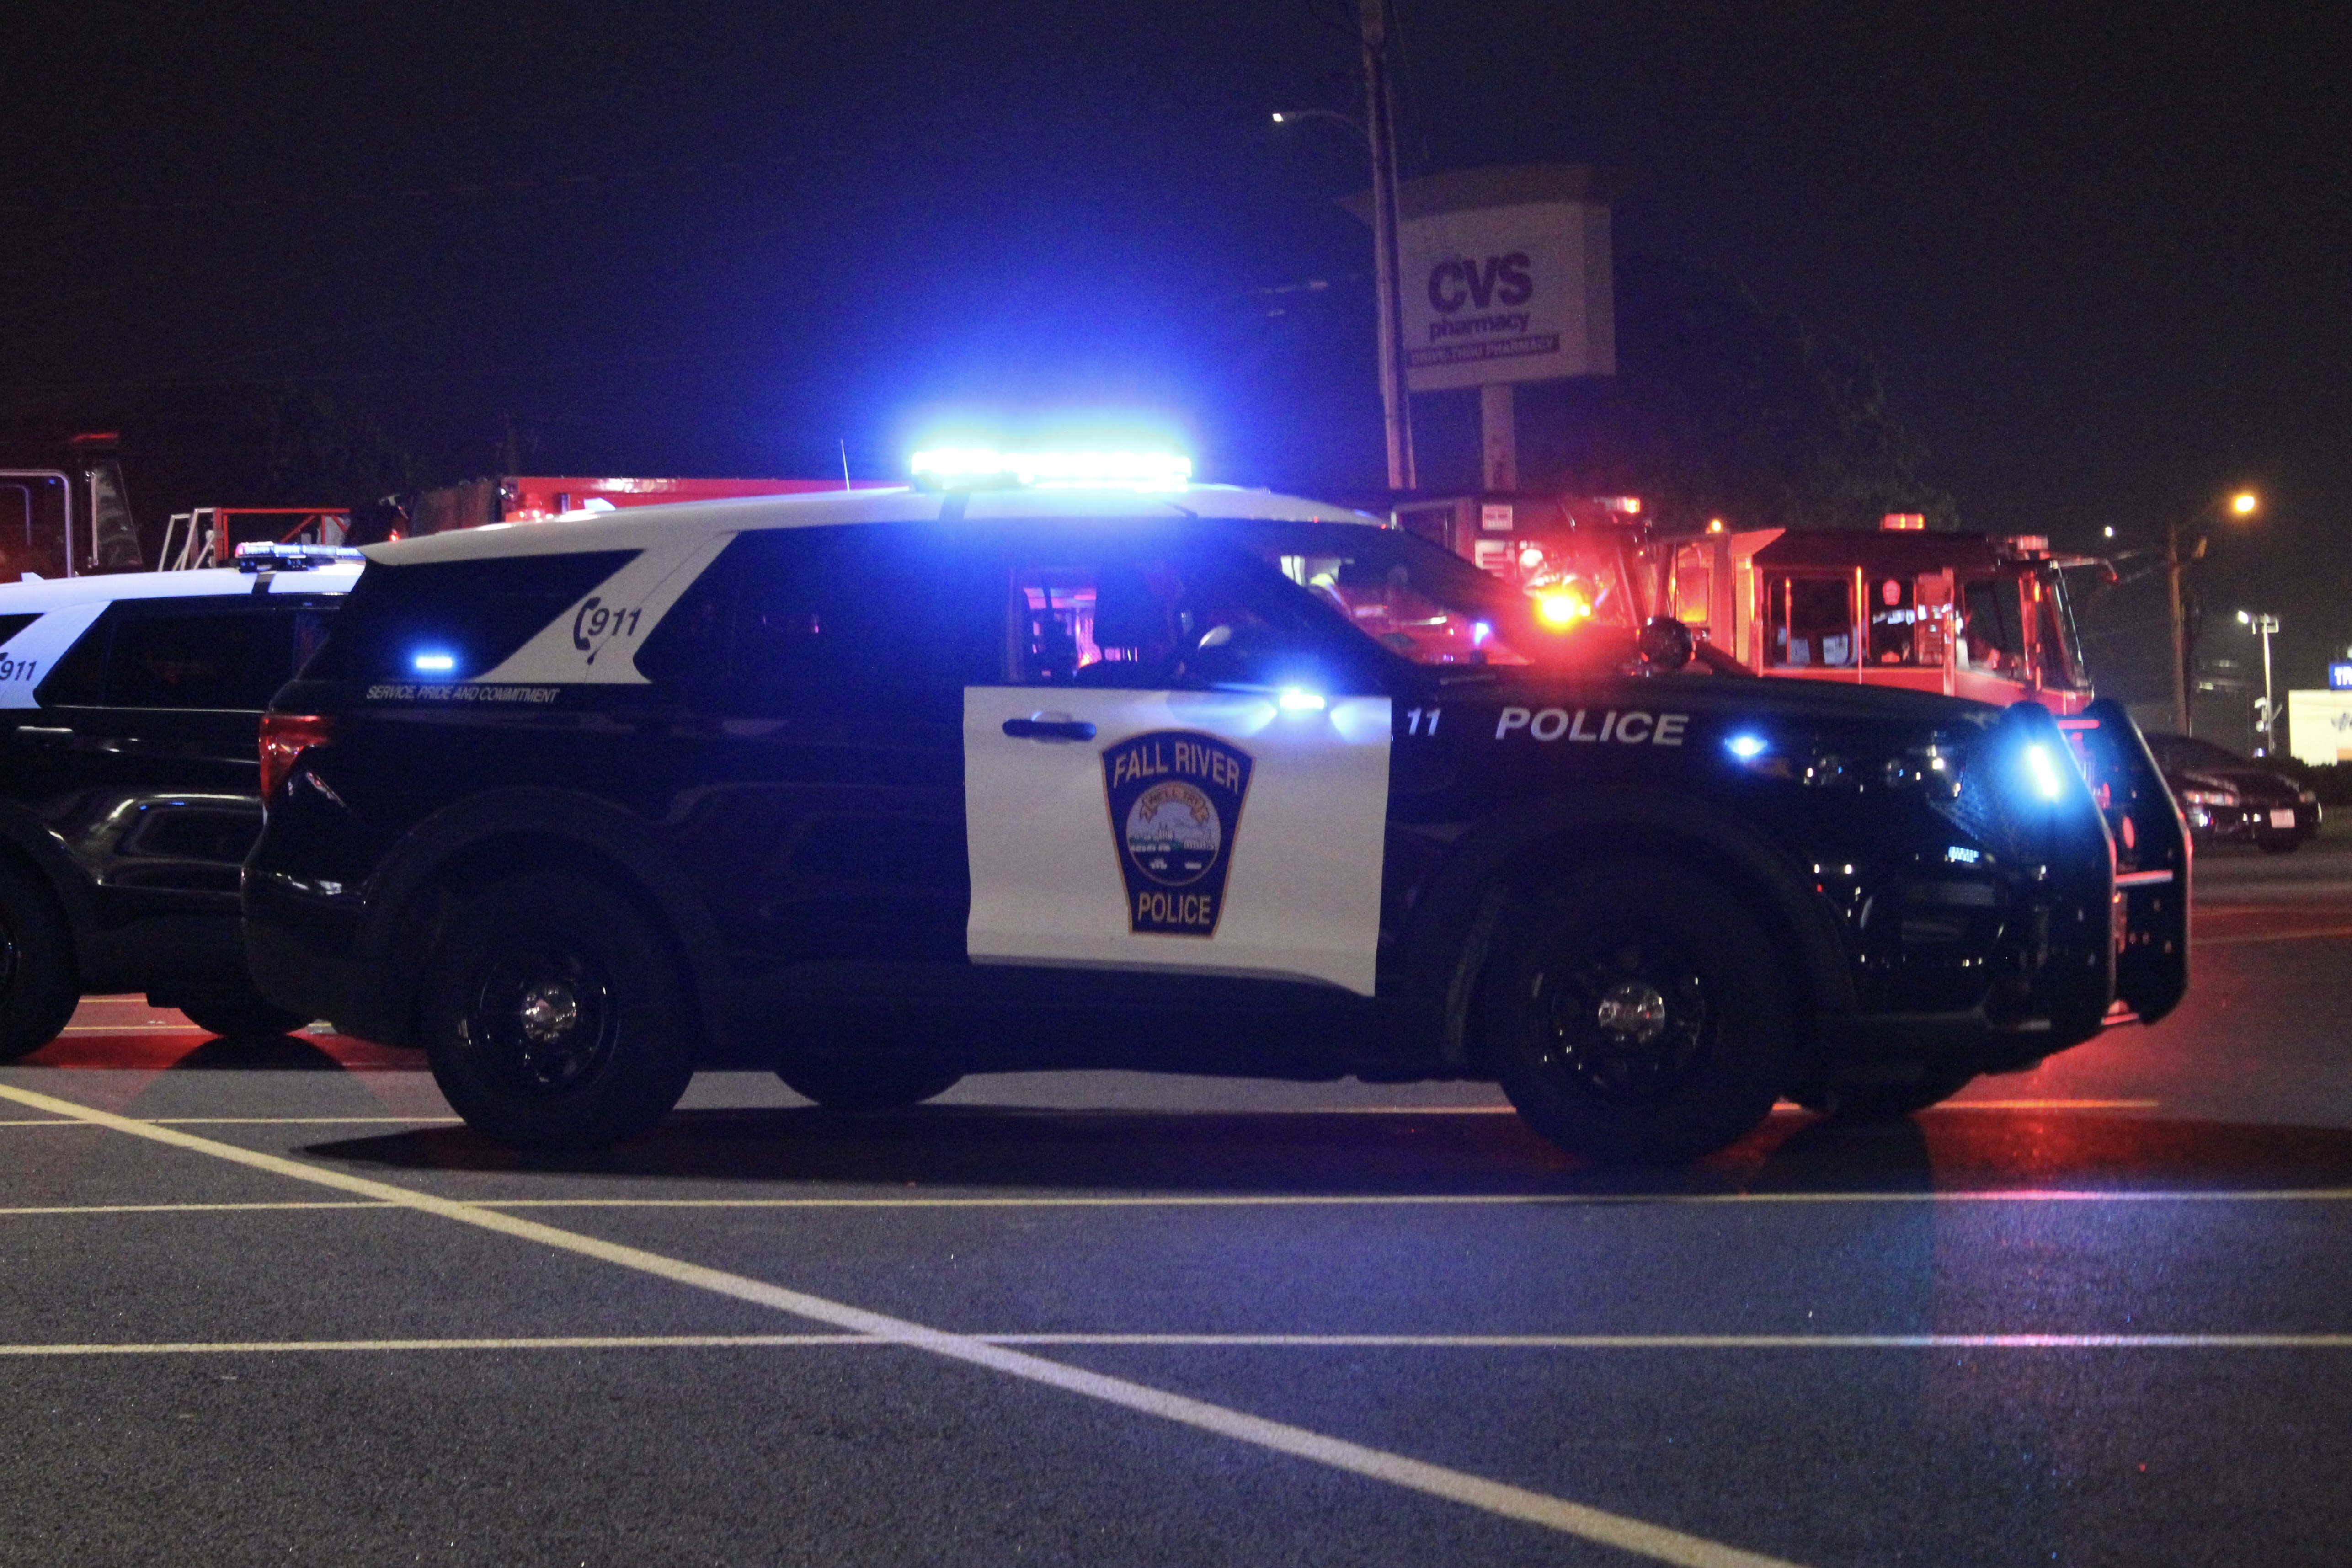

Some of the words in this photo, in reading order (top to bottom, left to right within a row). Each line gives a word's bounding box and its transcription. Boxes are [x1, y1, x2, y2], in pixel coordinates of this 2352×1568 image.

[1429, 252, 1533, 313] CVS
[1430, 313, 1530, 343] pharmacy
[588, 608, 642, 636] 911
[0, 661, 37, 681] 911
[417, 685, 453, 700] PRIDE
[452, 686, 477, 700] AND
[479, 687, 560, 703] COMMITMENT
[1408, 708, 1441, 736] 11
[1495, 707, 1689, 746] POLICE
[1114, 742, 1168, 789] FALL
[1175, 741, 1240, 794] RIVER
[1138, 893, 1211, 925] POLICE
